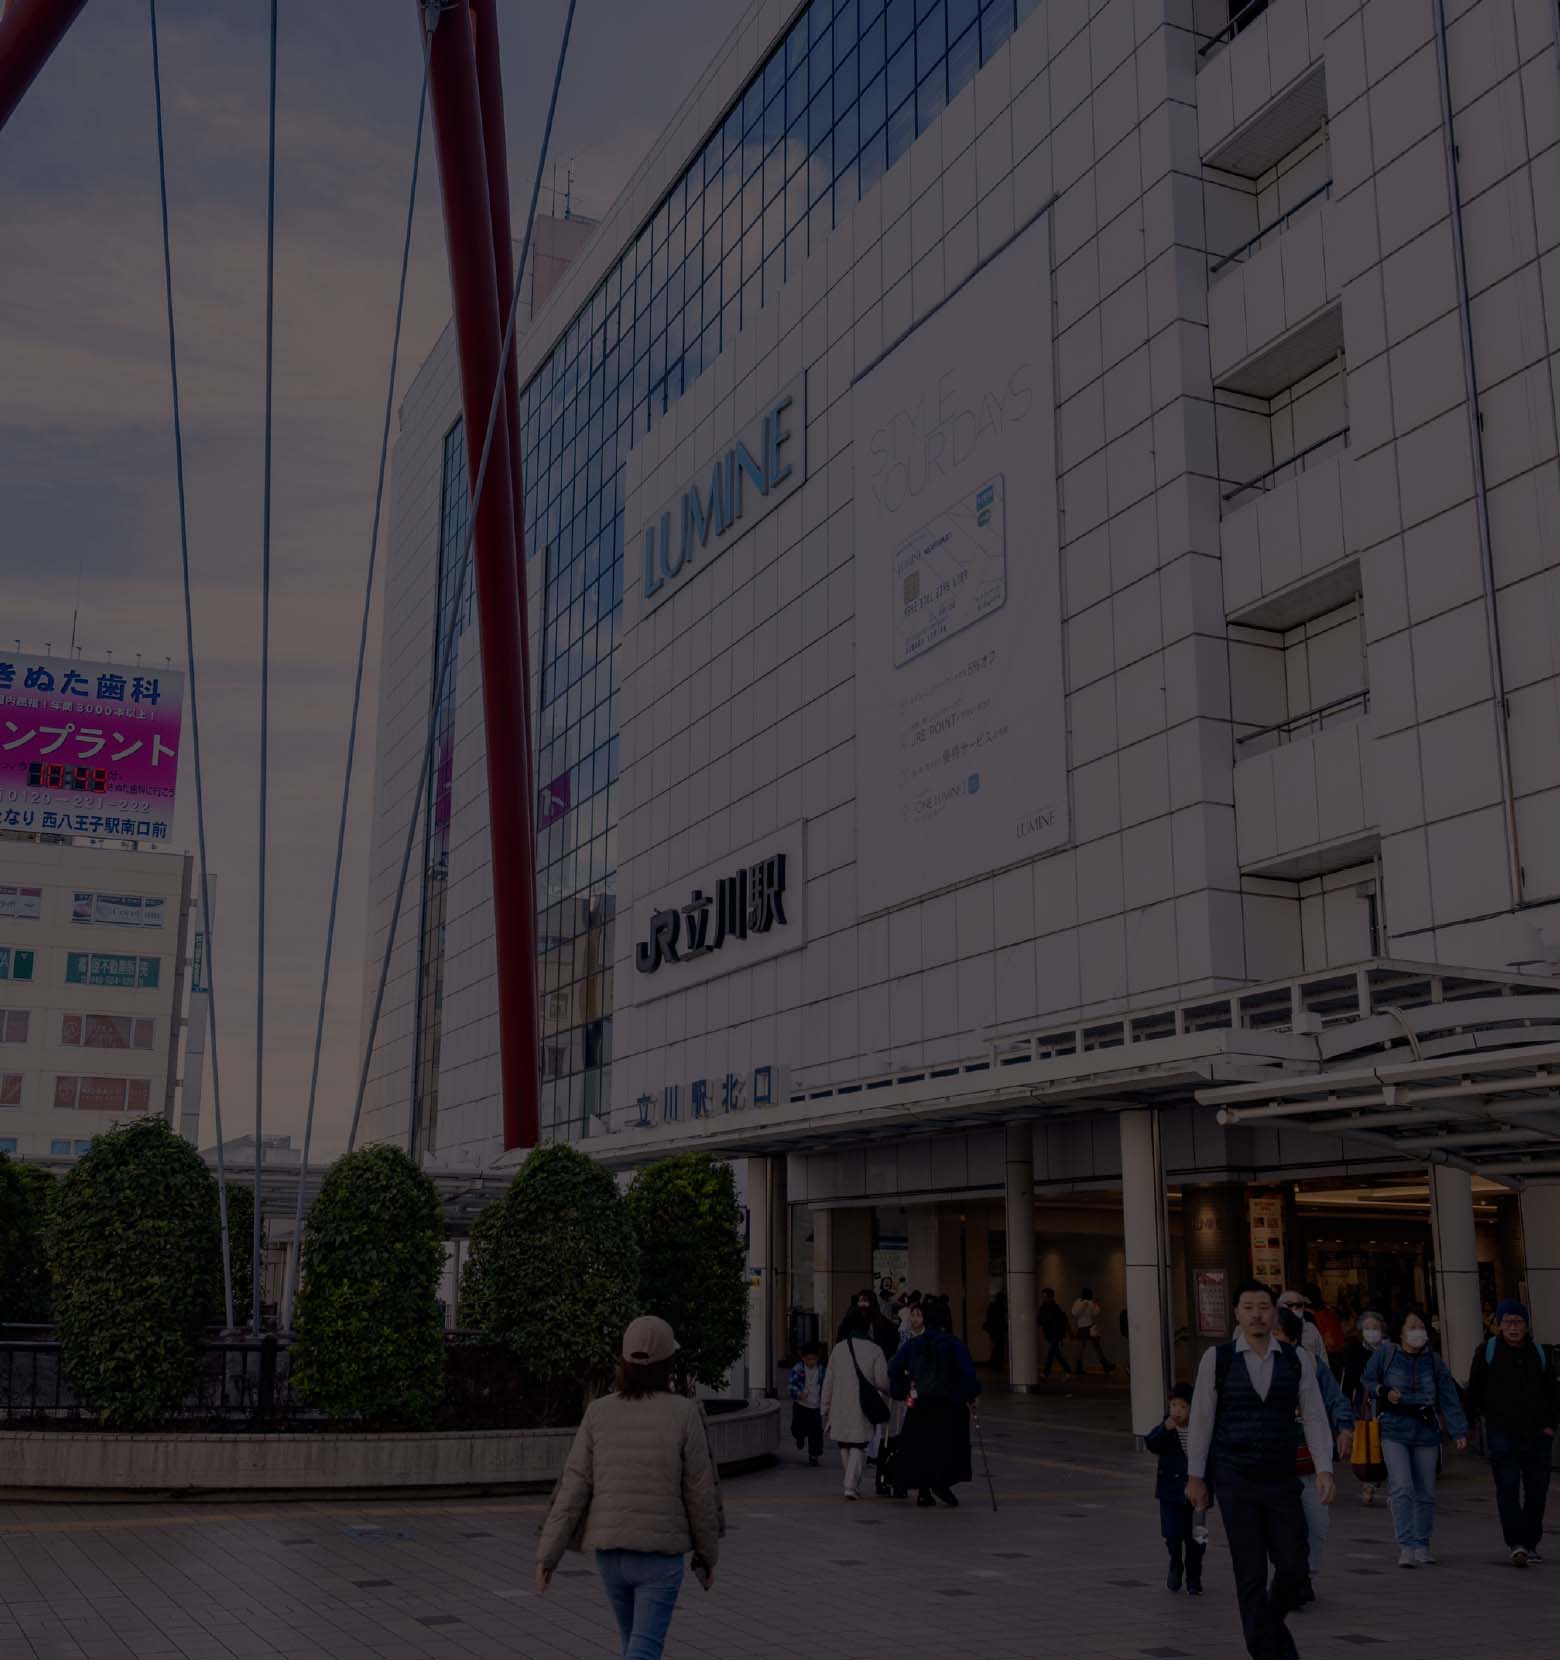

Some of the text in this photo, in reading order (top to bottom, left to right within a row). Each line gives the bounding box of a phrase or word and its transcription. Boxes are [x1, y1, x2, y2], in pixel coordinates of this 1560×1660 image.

[644, 395, 792, 599] LUMINE
[0, 662, 161, 706] きぬた歯科
[2, 720, 176, 767] ンプラント
[42, 811, 168, 839] 西八王子駅南口前
[1016, 811, 1056, 840] LUMINE
[635, 853, 788, 974] JR立川駅
[634, 1065, 775, 1127] 立川駅北口
